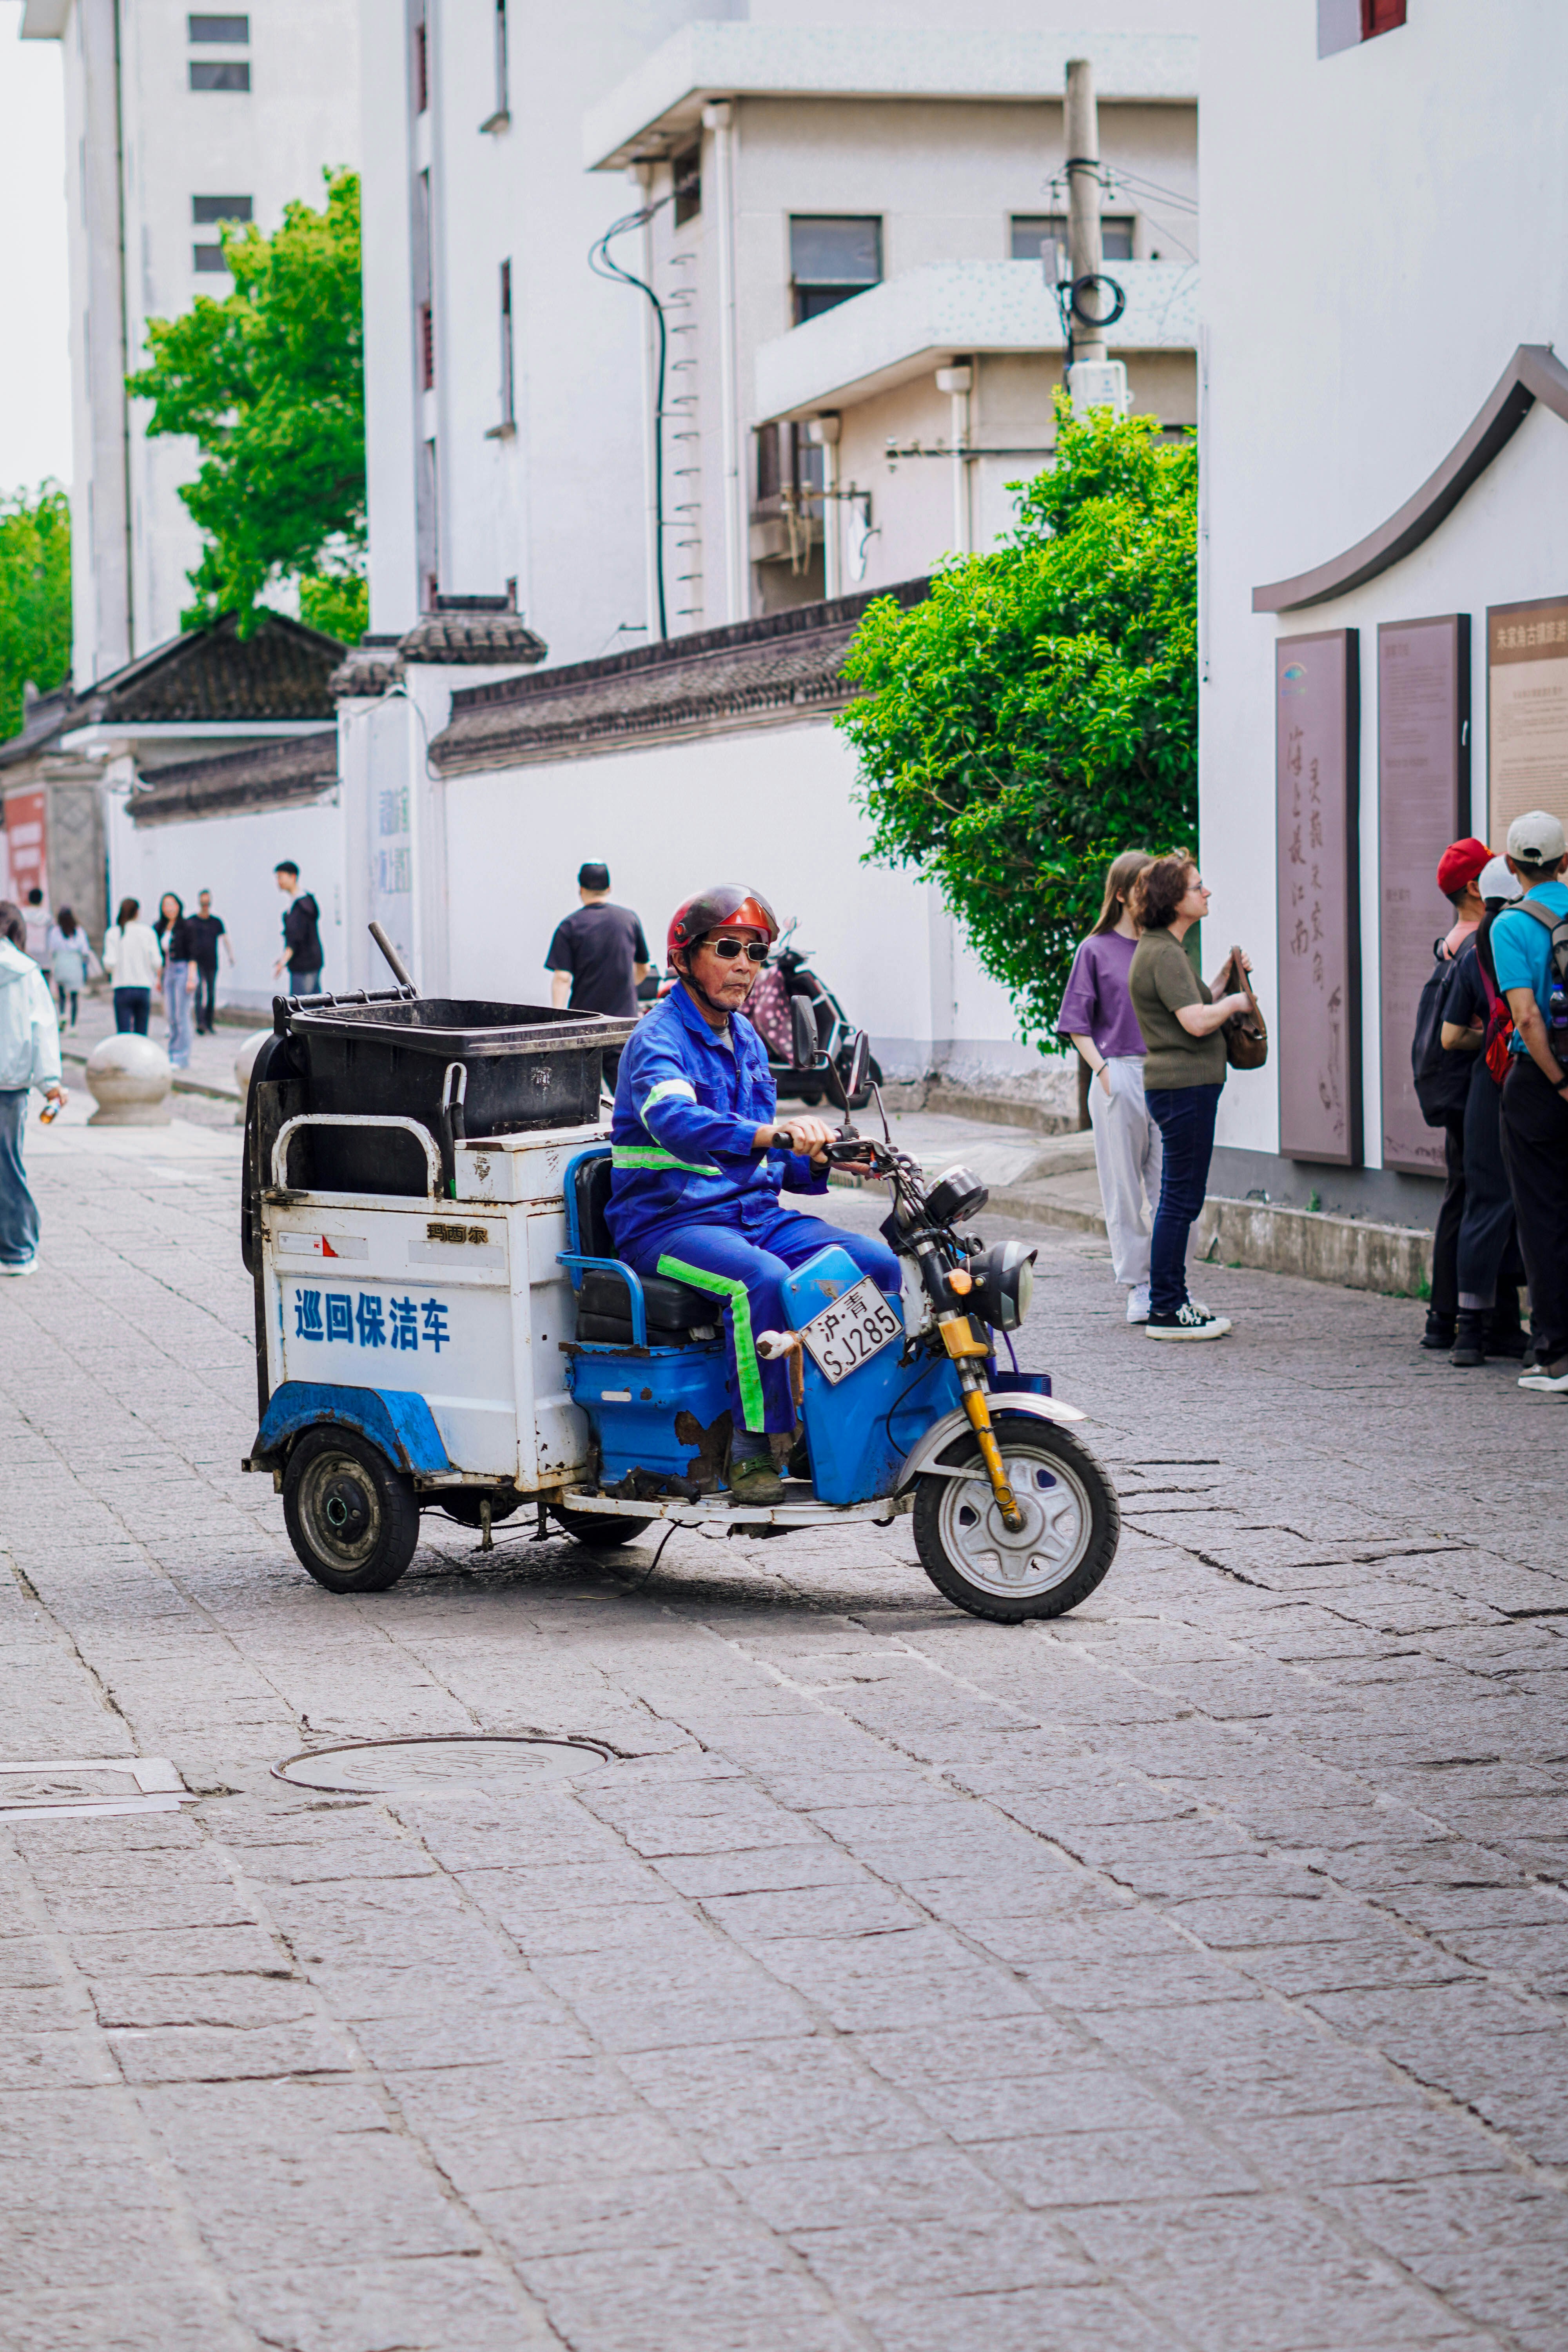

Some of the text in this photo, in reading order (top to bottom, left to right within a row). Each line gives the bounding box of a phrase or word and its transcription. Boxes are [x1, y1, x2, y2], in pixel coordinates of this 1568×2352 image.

[426, 1222, 489, 1245] 玛西尔
[294, 1289, 450, 1353] 巡回保洁车
[824, 1305, 895, 1376] SJ285
